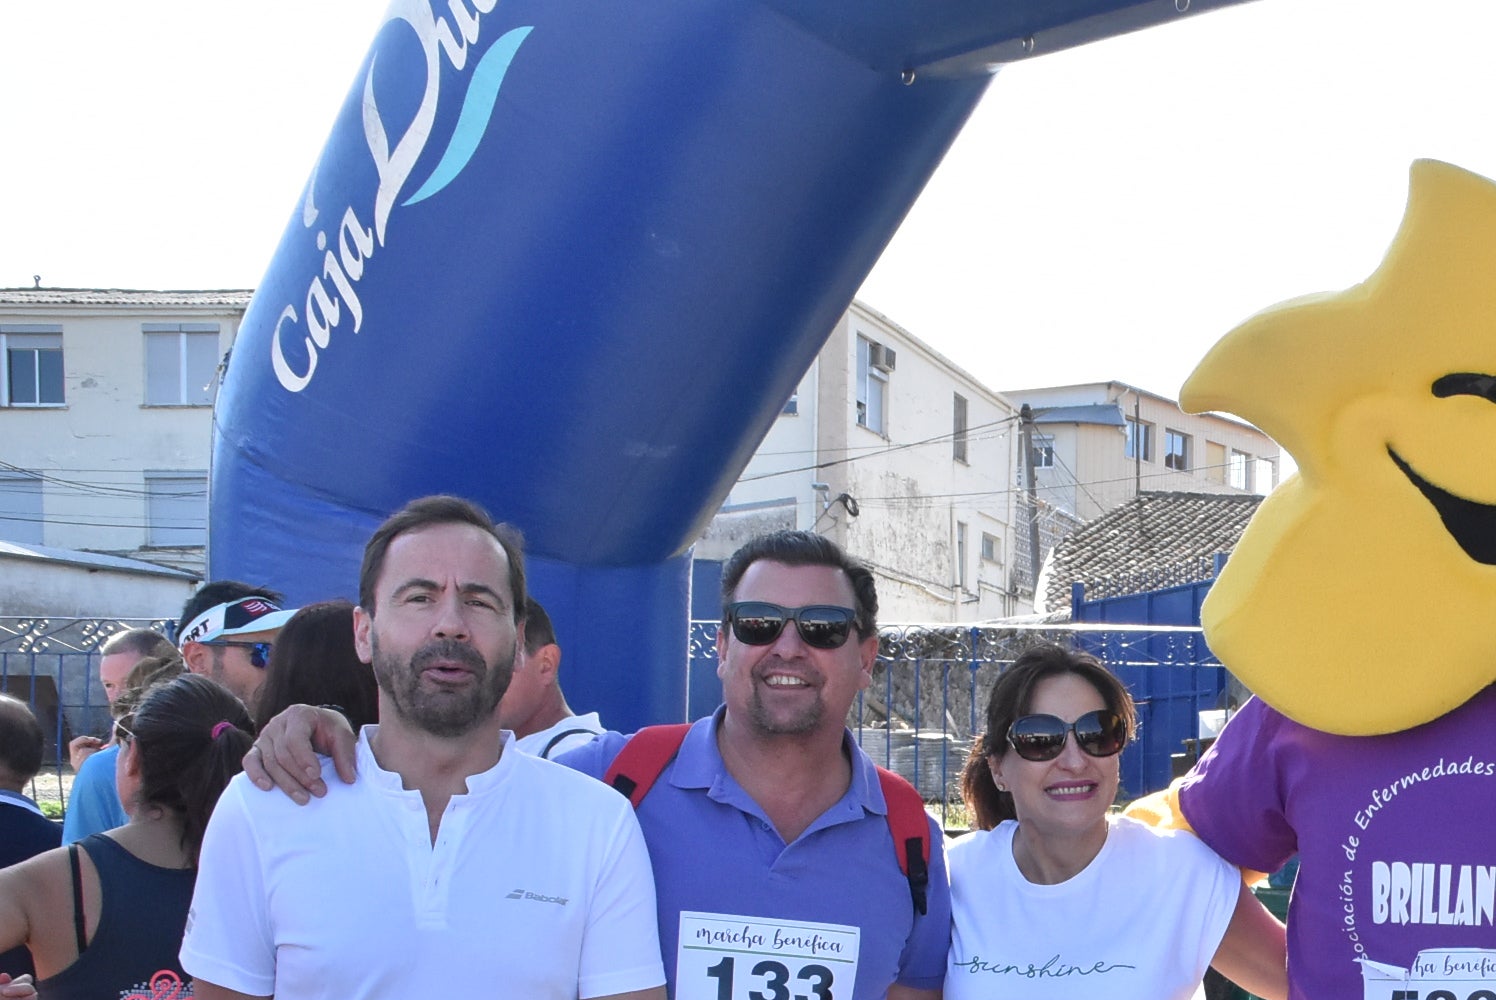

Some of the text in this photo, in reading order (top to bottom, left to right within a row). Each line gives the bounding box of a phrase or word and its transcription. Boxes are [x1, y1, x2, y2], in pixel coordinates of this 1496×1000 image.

[271, 204, 374, 393] Caja
[1353, 755, 1495, 831] Enfermedades
[1341, 835, 1360, 861] de
[696, 925, 844, 954] marcha benéfica
[1338, 868, 1370, 960] sociación
[953, 954, 1136, 979] sunshine
